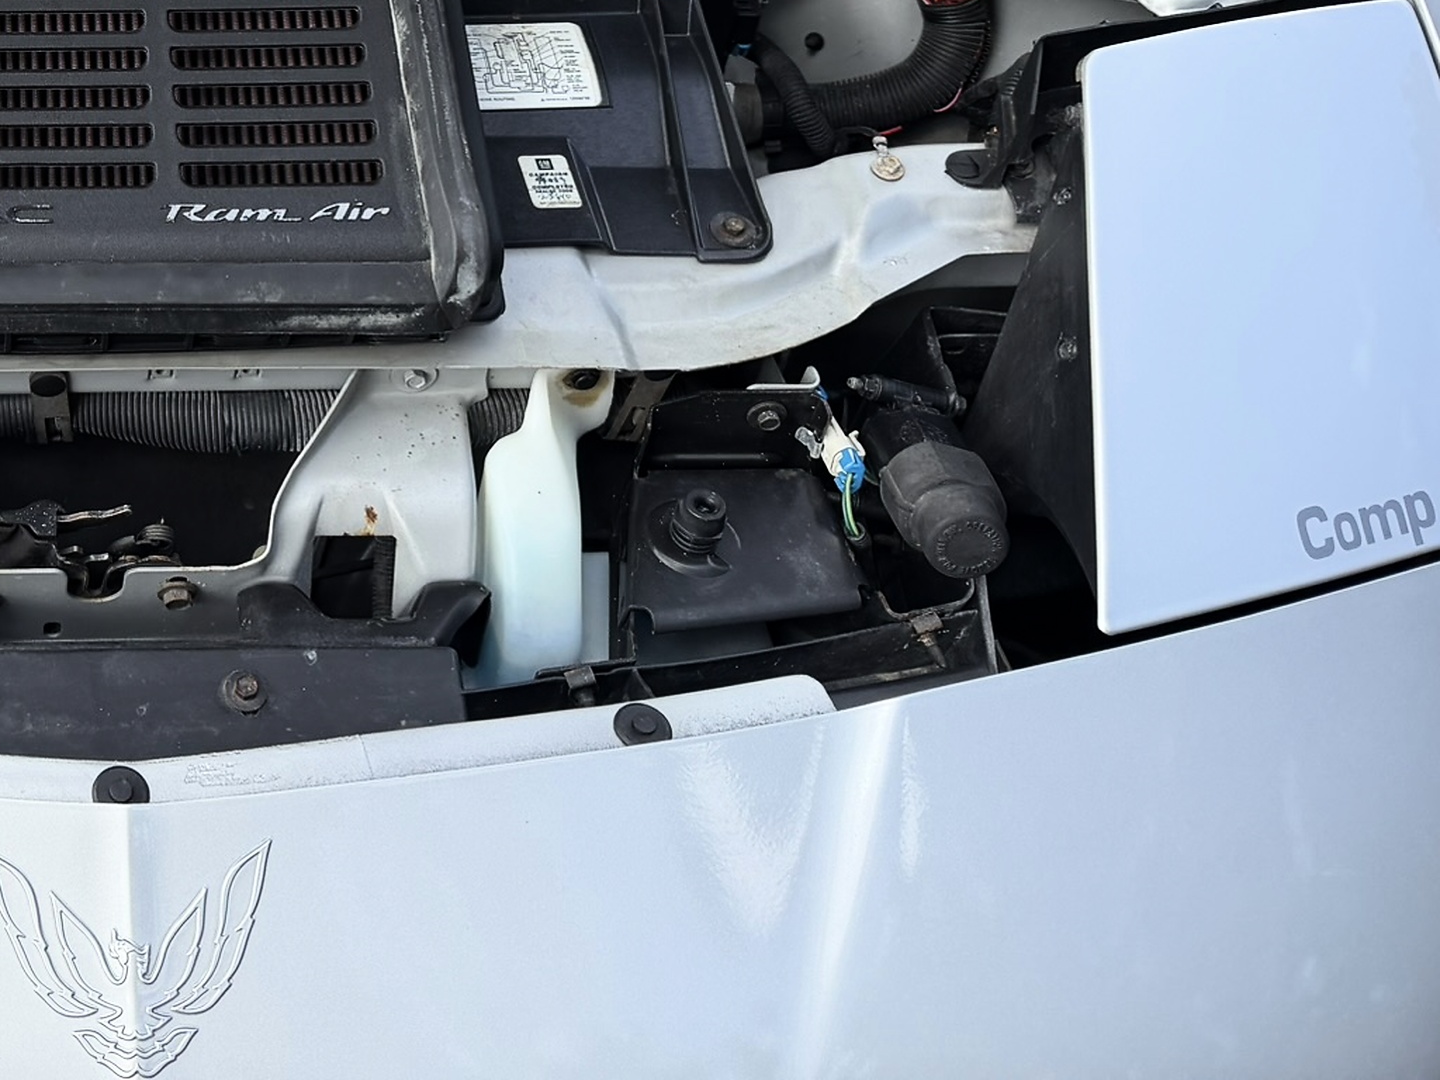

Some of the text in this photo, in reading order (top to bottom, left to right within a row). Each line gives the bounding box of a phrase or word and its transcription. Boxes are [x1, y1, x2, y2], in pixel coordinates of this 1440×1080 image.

[165, 200, 390, 222] Ram Air
[1296, 490, 1436, 560] Comp
